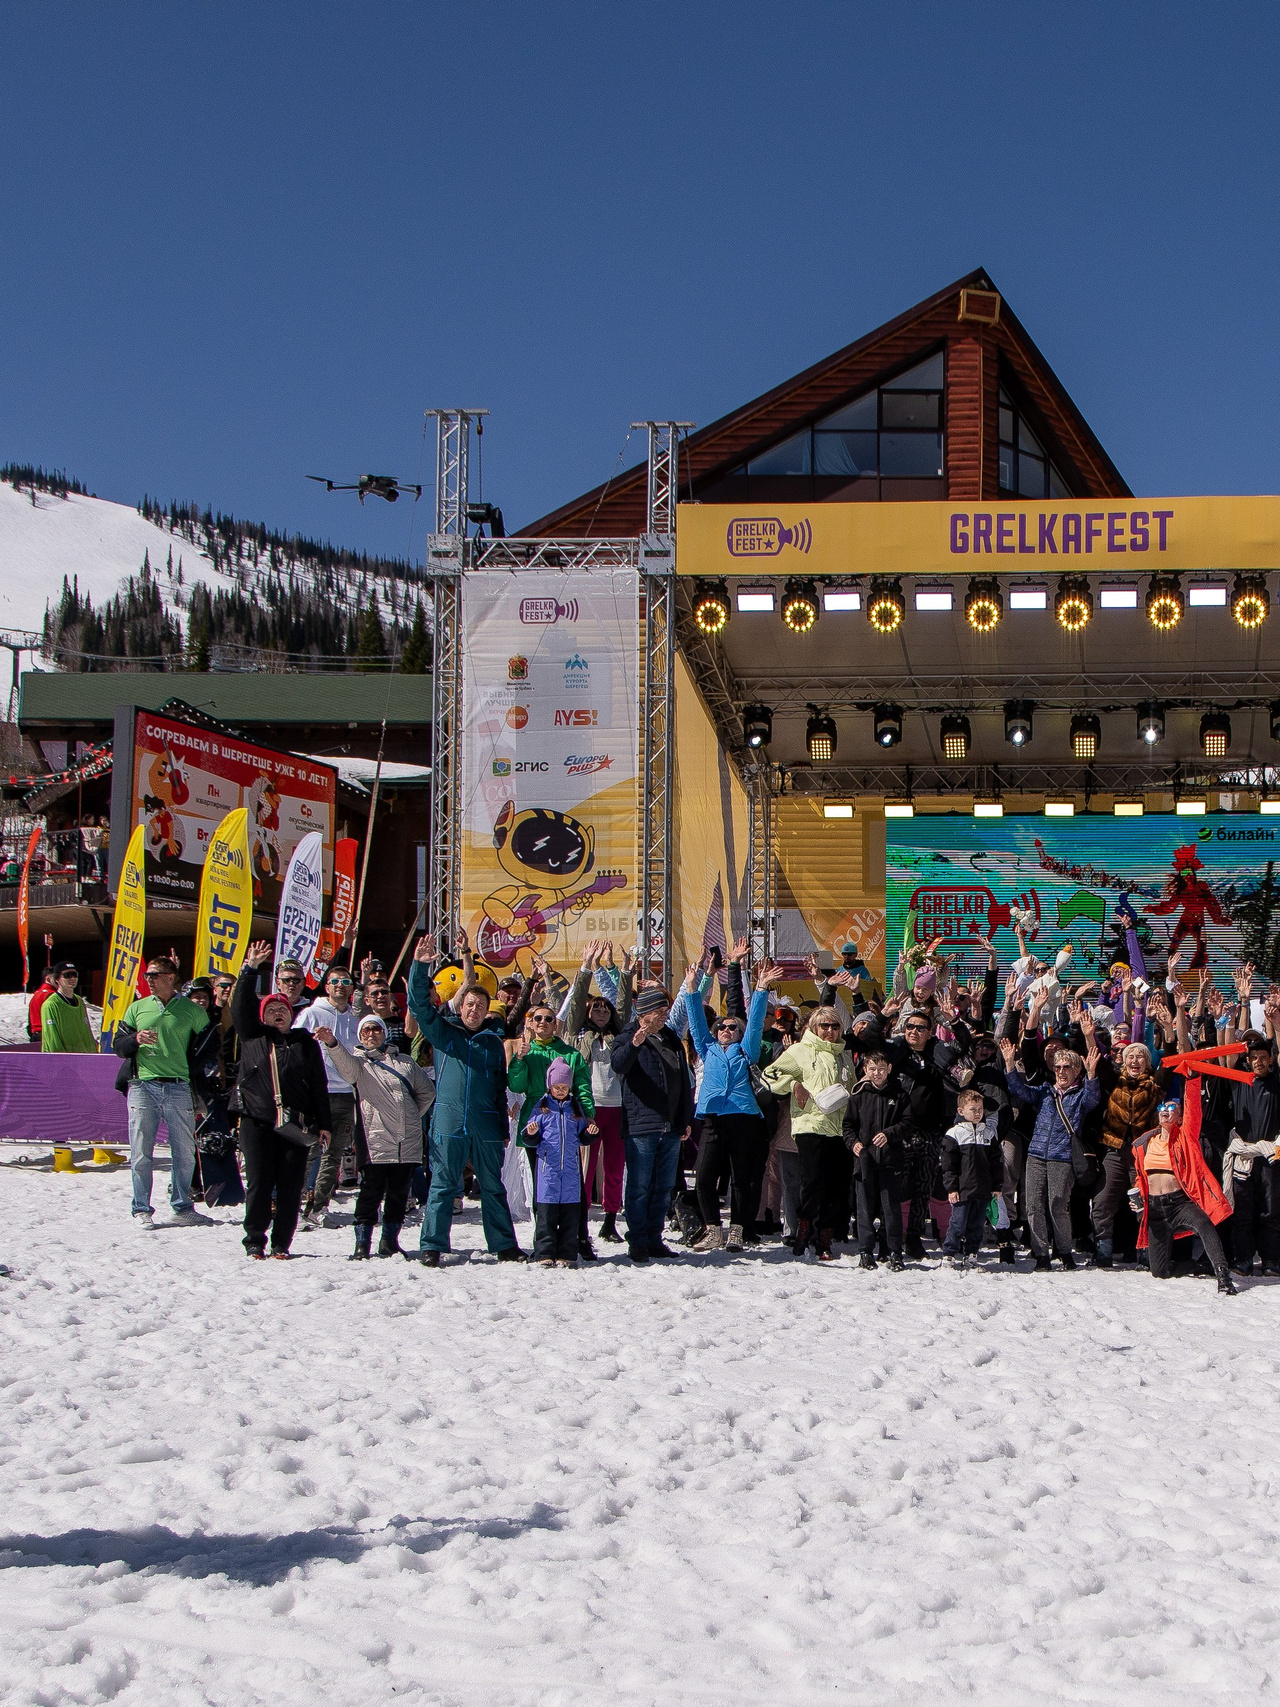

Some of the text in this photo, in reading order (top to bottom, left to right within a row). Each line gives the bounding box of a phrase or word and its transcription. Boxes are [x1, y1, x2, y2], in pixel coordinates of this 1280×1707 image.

[735, 523, 776, 537] GRELKA
[950, 511, 1174, 554] GRELKAFEST
[736, 538, 763, 552] FEST
[525, 601, 554, 611] GRELKA
[525, 611, 544, 620] FEST
[554, 710, 599, 726] AYS!
[146, 724, 329, 787] СОГРЕВАЕМ В ШЕРЕГЕШЕ УЖЕ 10 ЛЕТ!
[563, 754, 606, 767] Europa
[515, 761, 550, 772] 2ГИС
[566, 762, 596, 775] plus
[1216, 827, 1275, 841] билайн
[153, 874, 171, 885] 10:00
[152, 901, 183, 909] БЫСТРО
[922, 894, 984, 914] GRELKA
[208, 893, 241, 977] FEST
